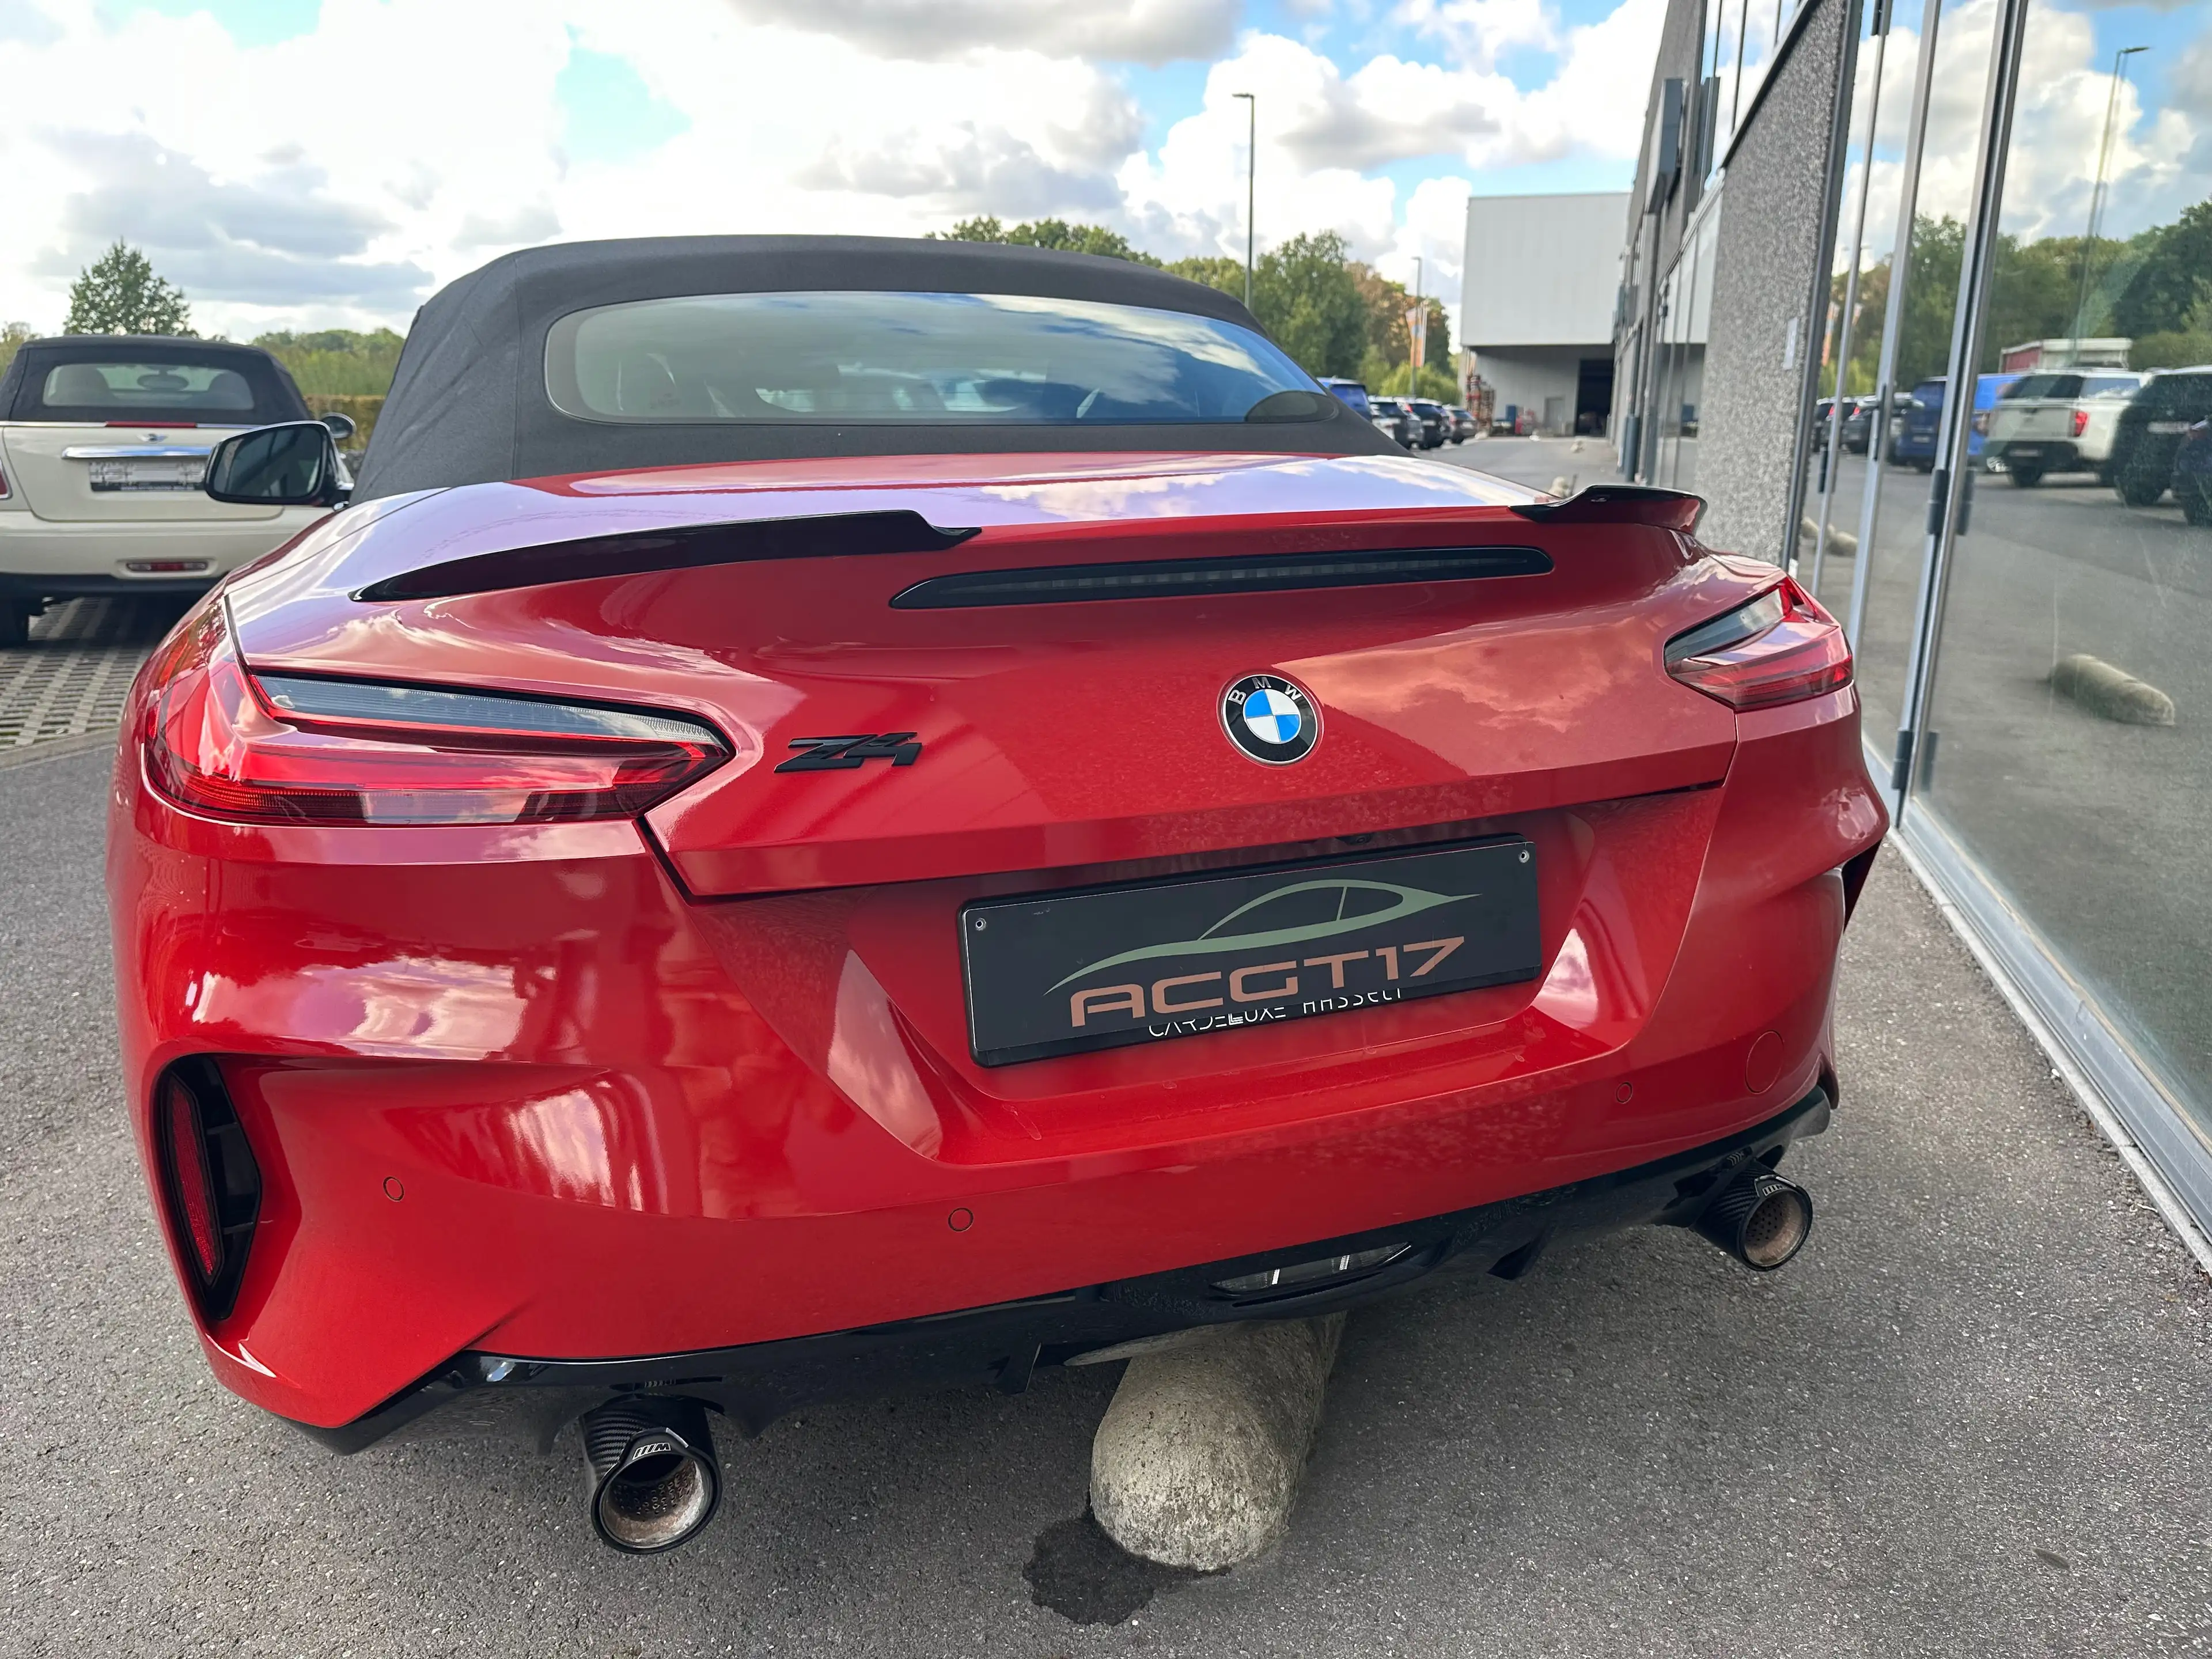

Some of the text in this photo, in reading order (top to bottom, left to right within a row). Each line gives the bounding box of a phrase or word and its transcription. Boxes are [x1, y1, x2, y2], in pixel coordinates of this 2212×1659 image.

[1228, 676, 1302, 705] BMW
[774, 732, 922, 773] Z4
[1070, 936, 1465, 1028] ACGT17
